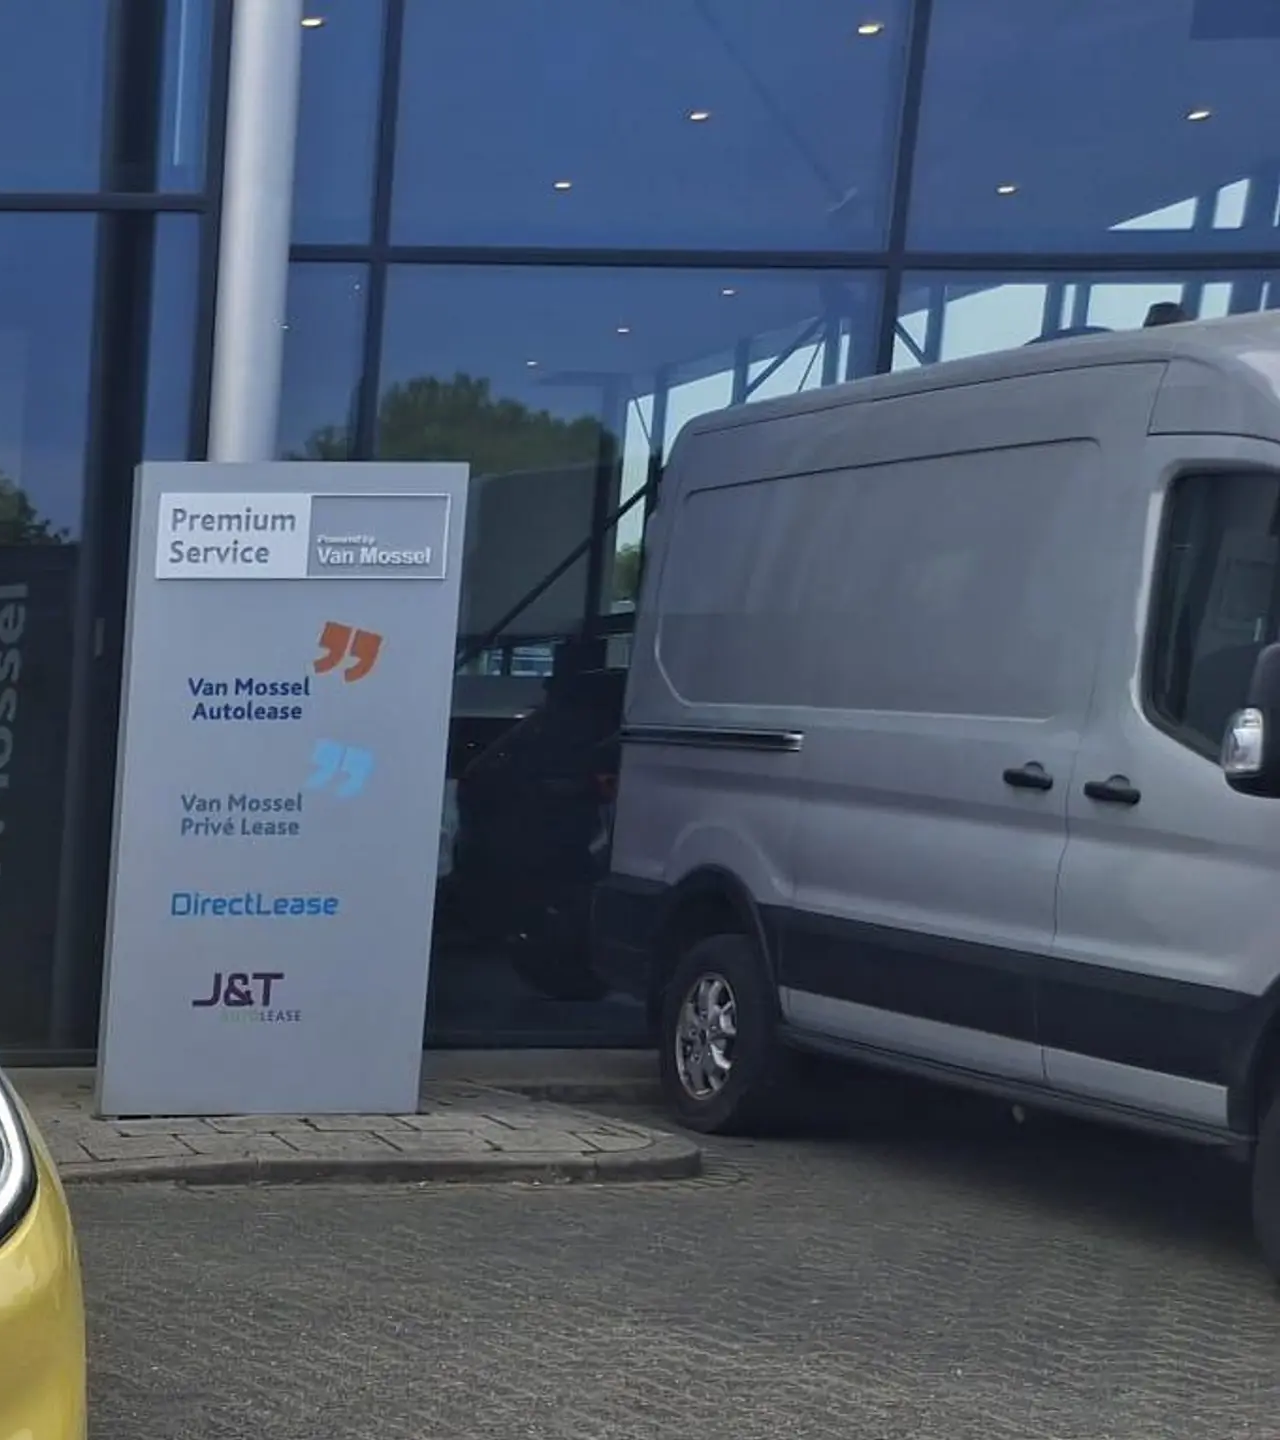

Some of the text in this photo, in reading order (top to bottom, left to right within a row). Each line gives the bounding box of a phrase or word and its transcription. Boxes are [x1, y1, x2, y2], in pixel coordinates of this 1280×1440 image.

[170, 507, 297, 533] Premium
[168, 538, 270, 565] Service
[317, 546, 432, 565] Van Mossel
[187, 676, 310, 697] Van Mossel
[192, 701, 303, 720] Autolease
[181, 792, 302, 813] Van Mossel
[180, 816, 300, 837] Privé Lease
[171, 892, 339, 917] DirectLease
[192, 971, 284, 1008] J&T
